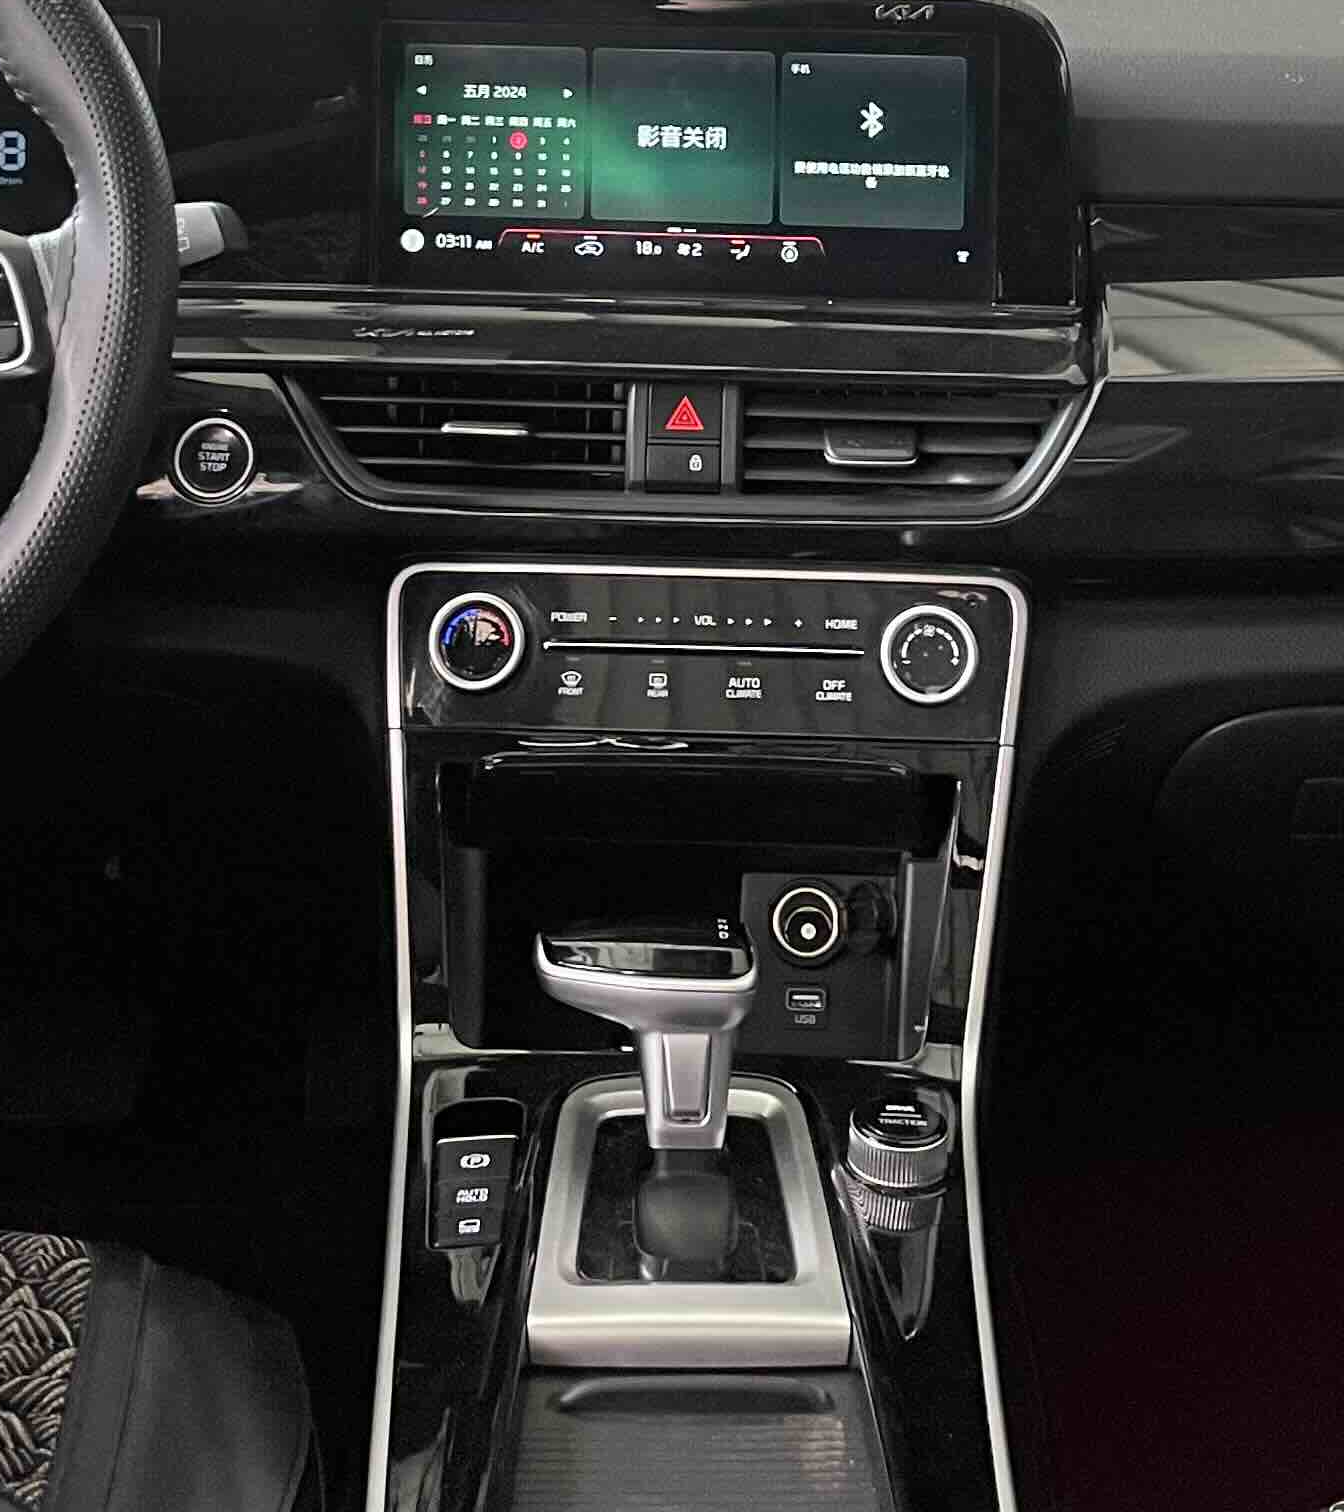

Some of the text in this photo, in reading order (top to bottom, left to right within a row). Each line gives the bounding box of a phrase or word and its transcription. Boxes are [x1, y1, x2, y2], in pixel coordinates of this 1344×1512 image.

[463, 84, 527, 99] 五月 2024
[637, 124, 727, 151] 影音关闭
[435, 233, 472, 250] 03:11
[520, 241, 545, 254] A/C
[197, 451, 231, 462] START
[199, 461, 228, 472] STOP
[550, 611, 588, 623] POWER
[694, 615, 718, 627] VOL
[824, 618, 859, 630] HOME
[728, 677, 761, 688] AUTO
[822, 679, 847, 691] OFF
[557, 686, 584, 696] FRONT
[725, 689, 763, 699] CLIMATE
[815, 691, 853, 702] CLIMATE
[794, 1014, 817, 1025] USB
